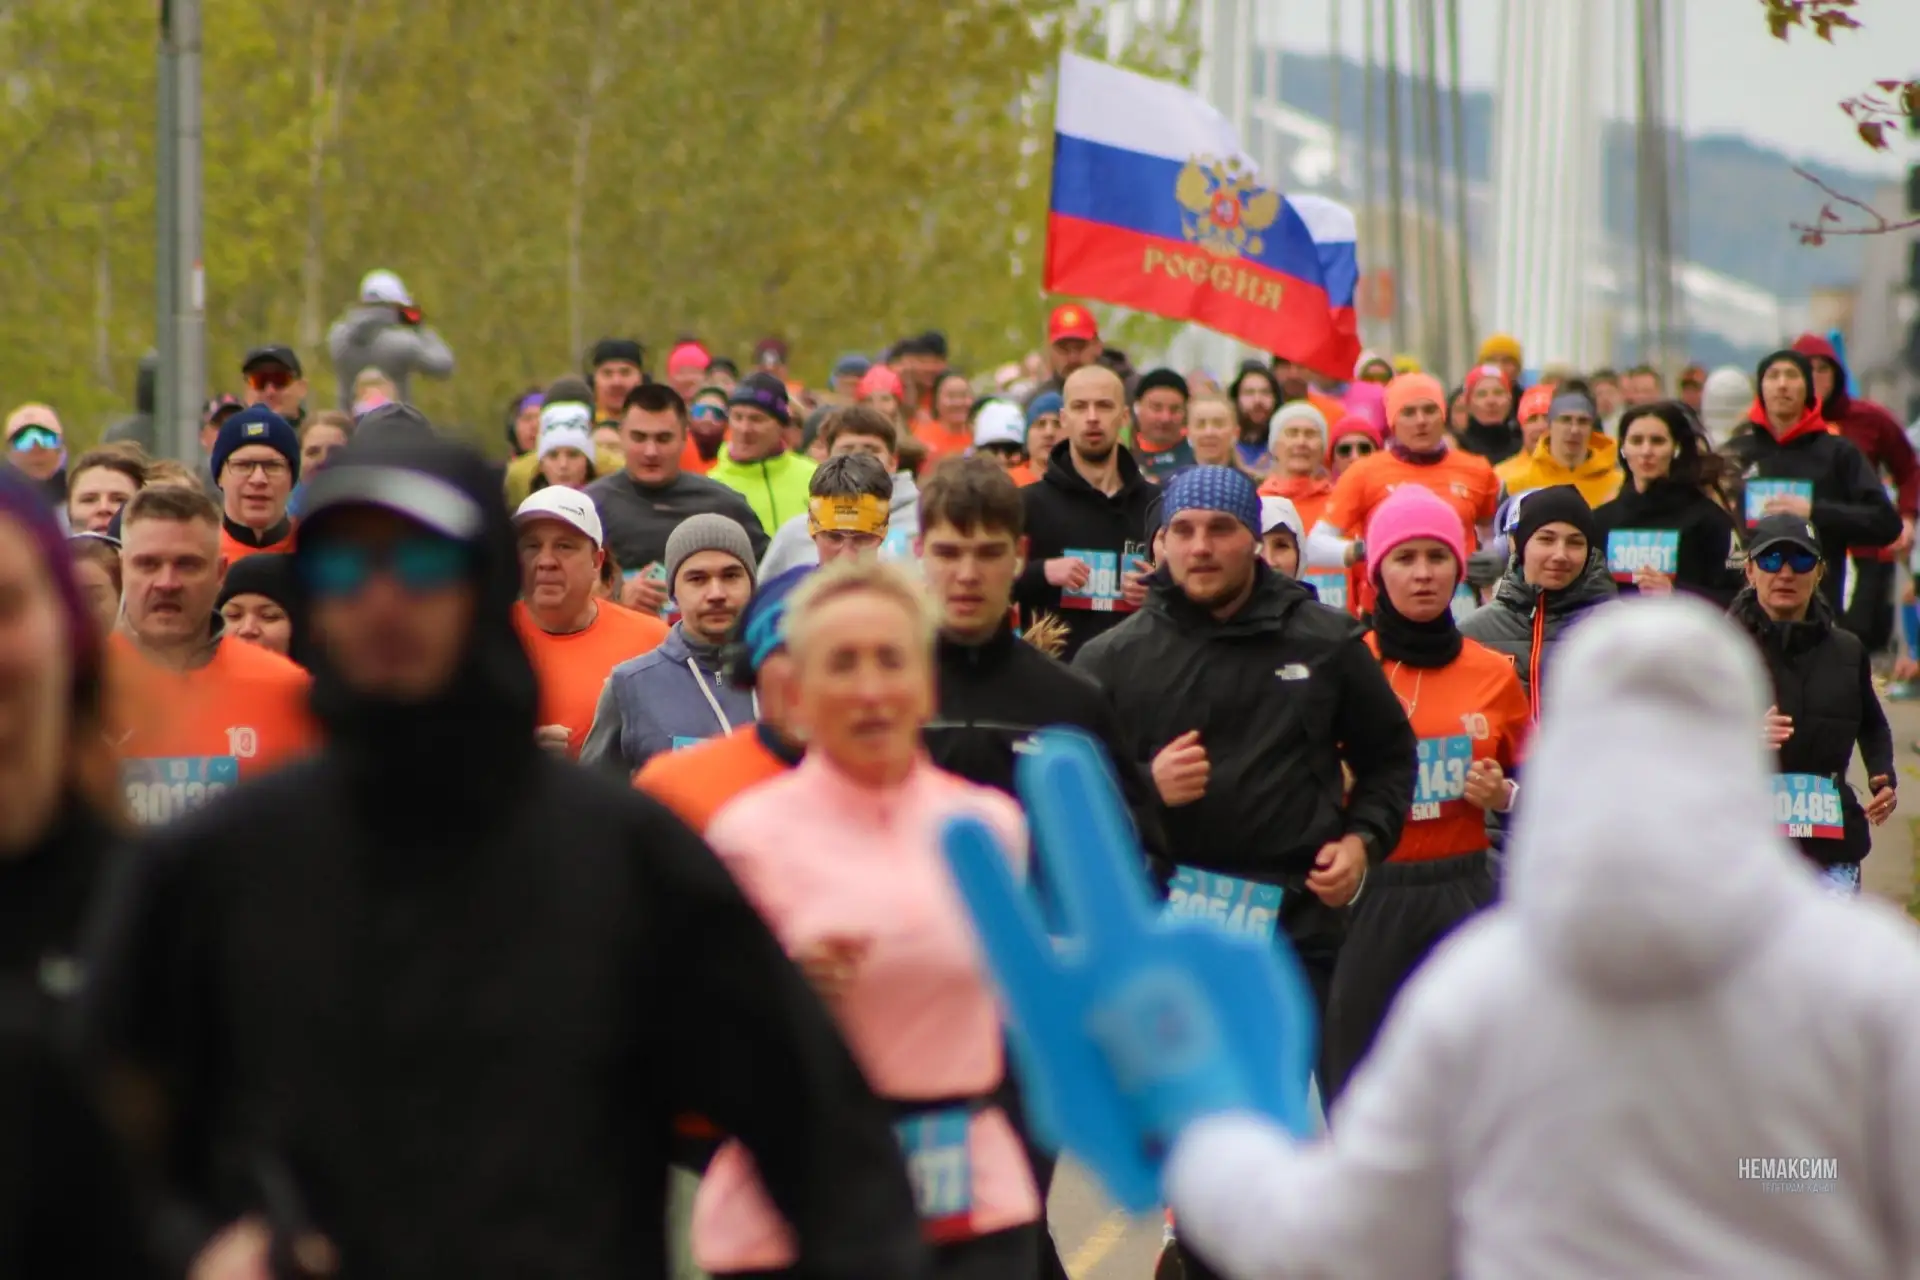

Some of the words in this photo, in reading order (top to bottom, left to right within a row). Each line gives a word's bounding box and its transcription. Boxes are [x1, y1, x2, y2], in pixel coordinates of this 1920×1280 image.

[1142, 244, 1283, 313] РОССИЯ
[224, 727, 257, 758] 10
[1418, 757, 1465, 800] 143
[1411, 801, 1440, 821] 5KM
[1774, 791, 1839, 823] 0485
[1788, 823, 1813, 838] 5KM
